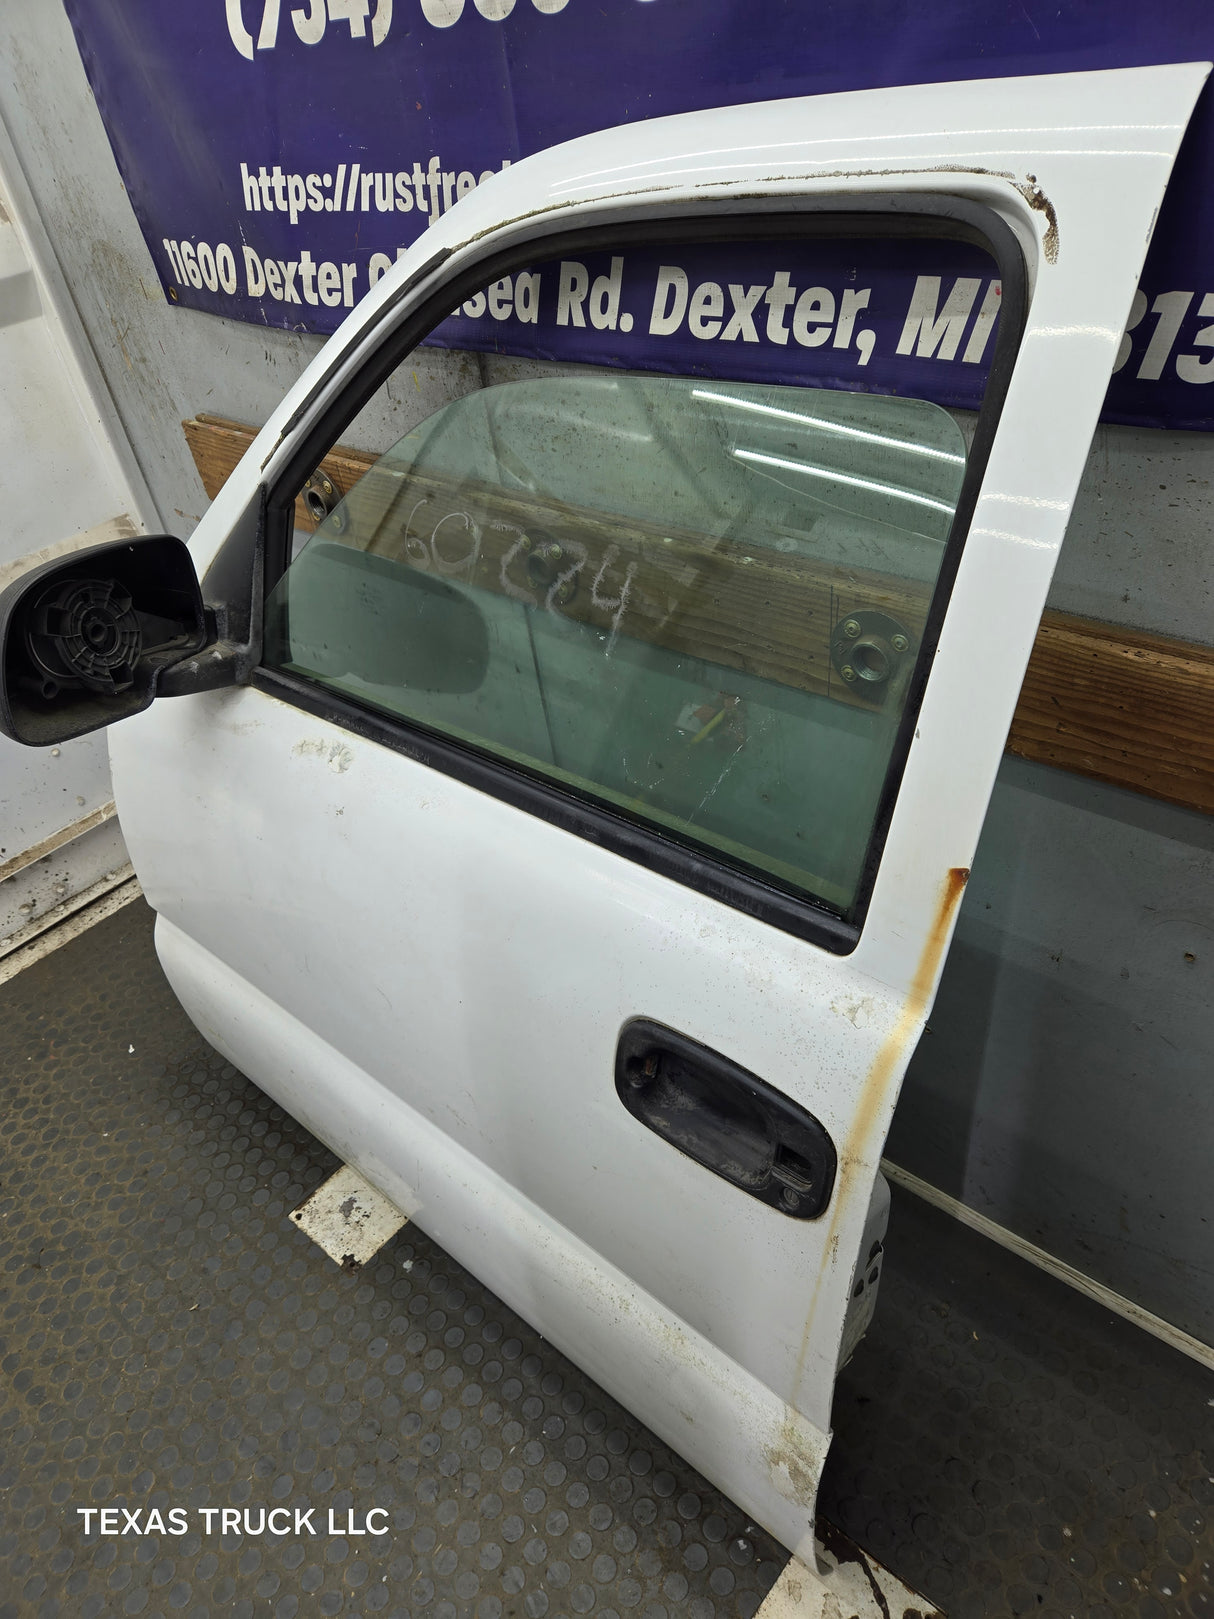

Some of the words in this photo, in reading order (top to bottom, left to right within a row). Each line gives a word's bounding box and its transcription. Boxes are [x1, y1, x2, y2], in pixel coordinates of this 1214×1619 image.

[162, 238, 237, 295] 11600
[242, 245, 358, 308] Dexter
[556, 256, 634, 332] Rd.
[649, 265, 877, 366] Dexter,
[895, 275, 1002, 364] MI
